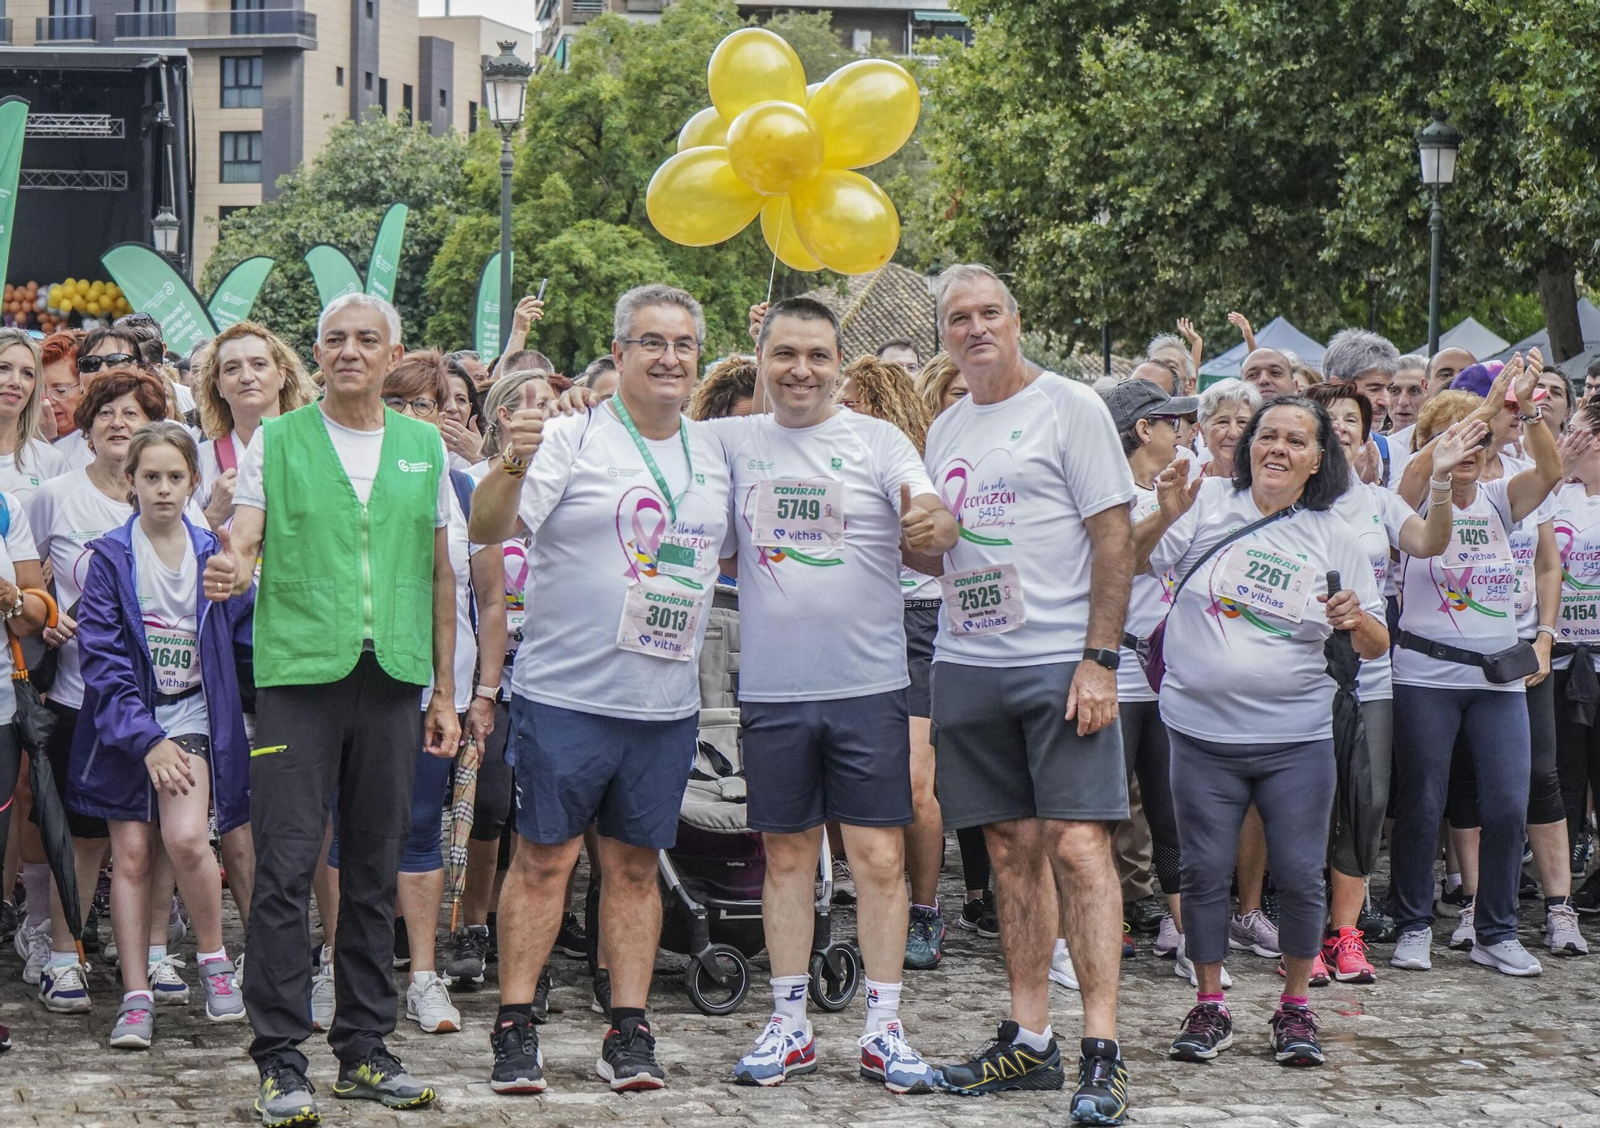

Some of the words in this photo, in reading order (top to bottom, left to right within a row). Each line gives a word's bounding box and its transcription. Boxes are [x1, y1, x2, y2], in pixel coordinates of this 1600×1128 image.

[777, 499, 821, 521] 5749
[978, 505, 1006, 519] 5415
[789, 530, 823, 541] vithas
[1457, 528, 1490, 546] 1426
[1470, 552, 1497, 561] vithas
[1569, 551, 1600, 562] coraz
[1582, 562, 1600, 571] 541
[1244, 560, 1292, 591] 2261
[1471, 574, 1513, 585] corazó
[1487, 585, 1508, 595] 5415
[958, 584, 1002, 611] 2525
[1251, 592, 1284, 609] vithas
[646, 605, 688, 632] 3013
[1562, 604, 1597, 620] 4154
[975, 616, 1007, 629] vithas
[1573, 628, 1600, 636] vithas
[654, 640, 682, 652] vithas
[151, 647, 191, 669] 1649
[159, 678, 190, 688] vithas
